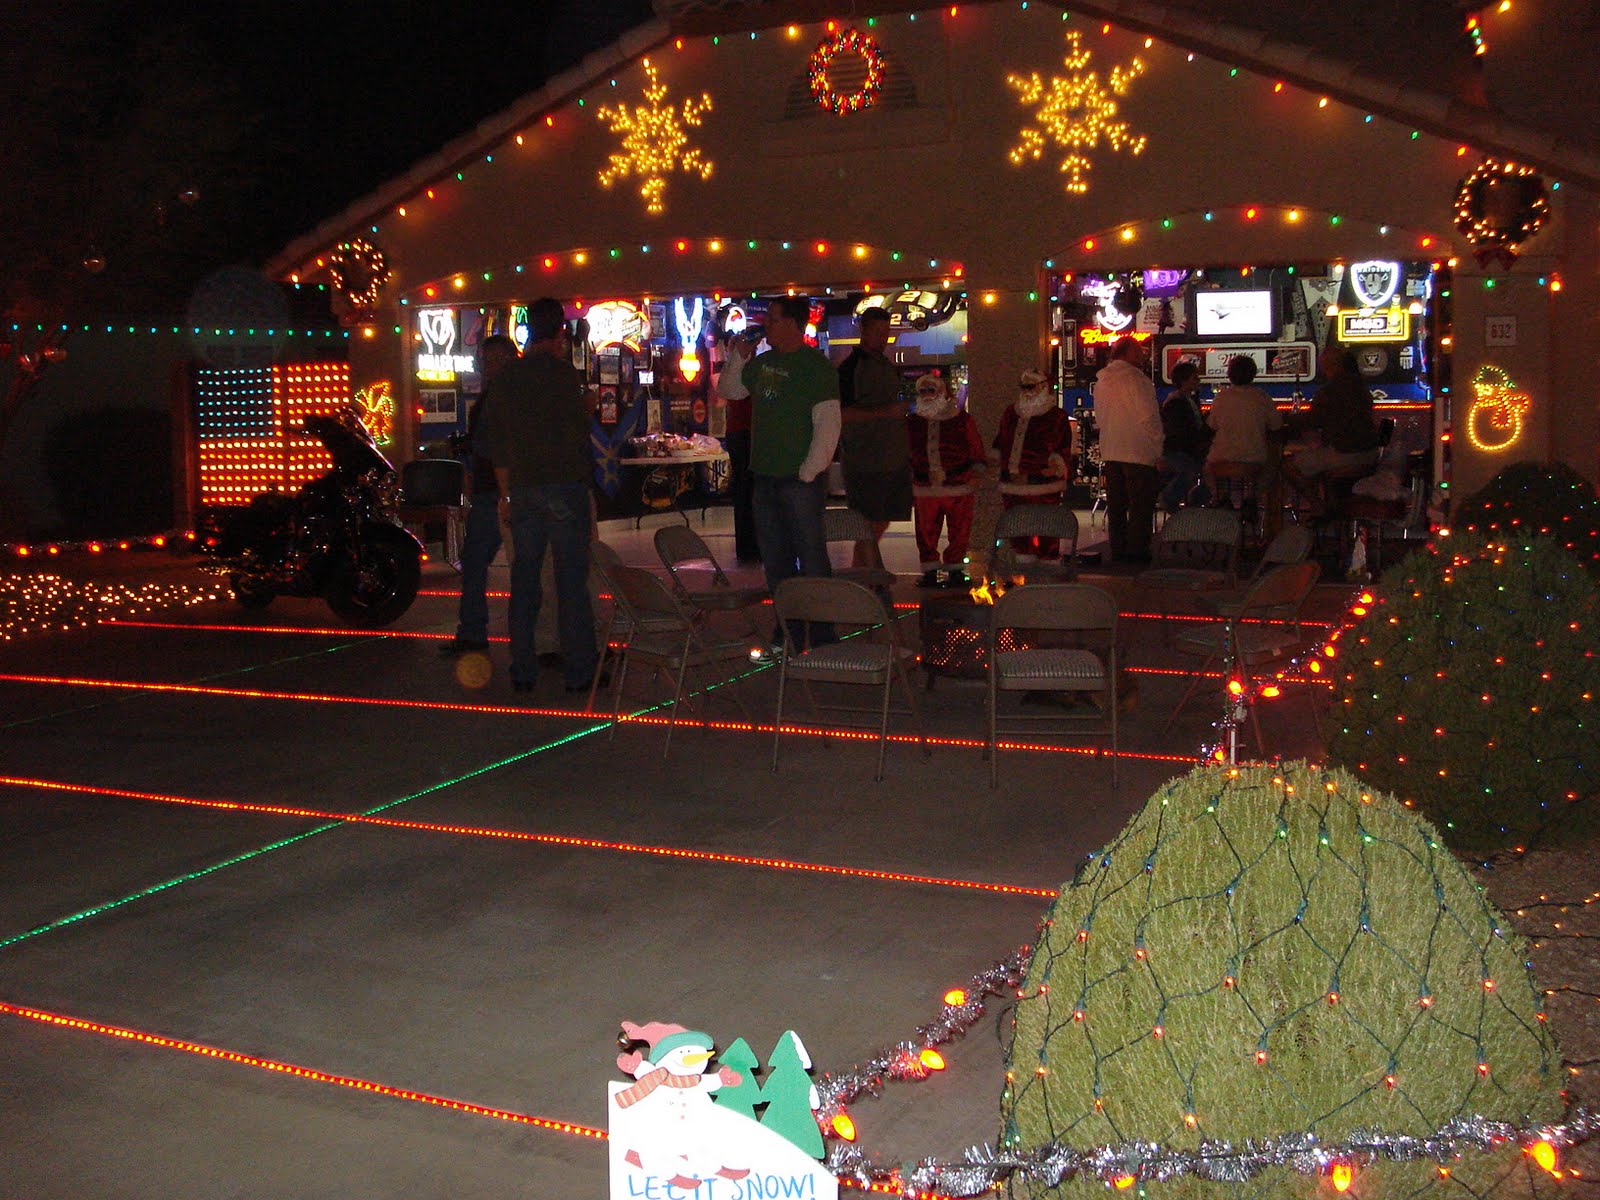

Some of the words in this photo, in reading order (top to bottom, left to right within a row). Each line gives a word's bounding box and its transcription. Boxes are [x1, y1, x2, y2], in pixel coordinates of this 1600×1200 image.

[896, 290, 921, 303] 2
[889, 313, 902, 326] 2
[1351, 318, 1385, 330] MGD
[1491, 323, 1512, 338] 632
